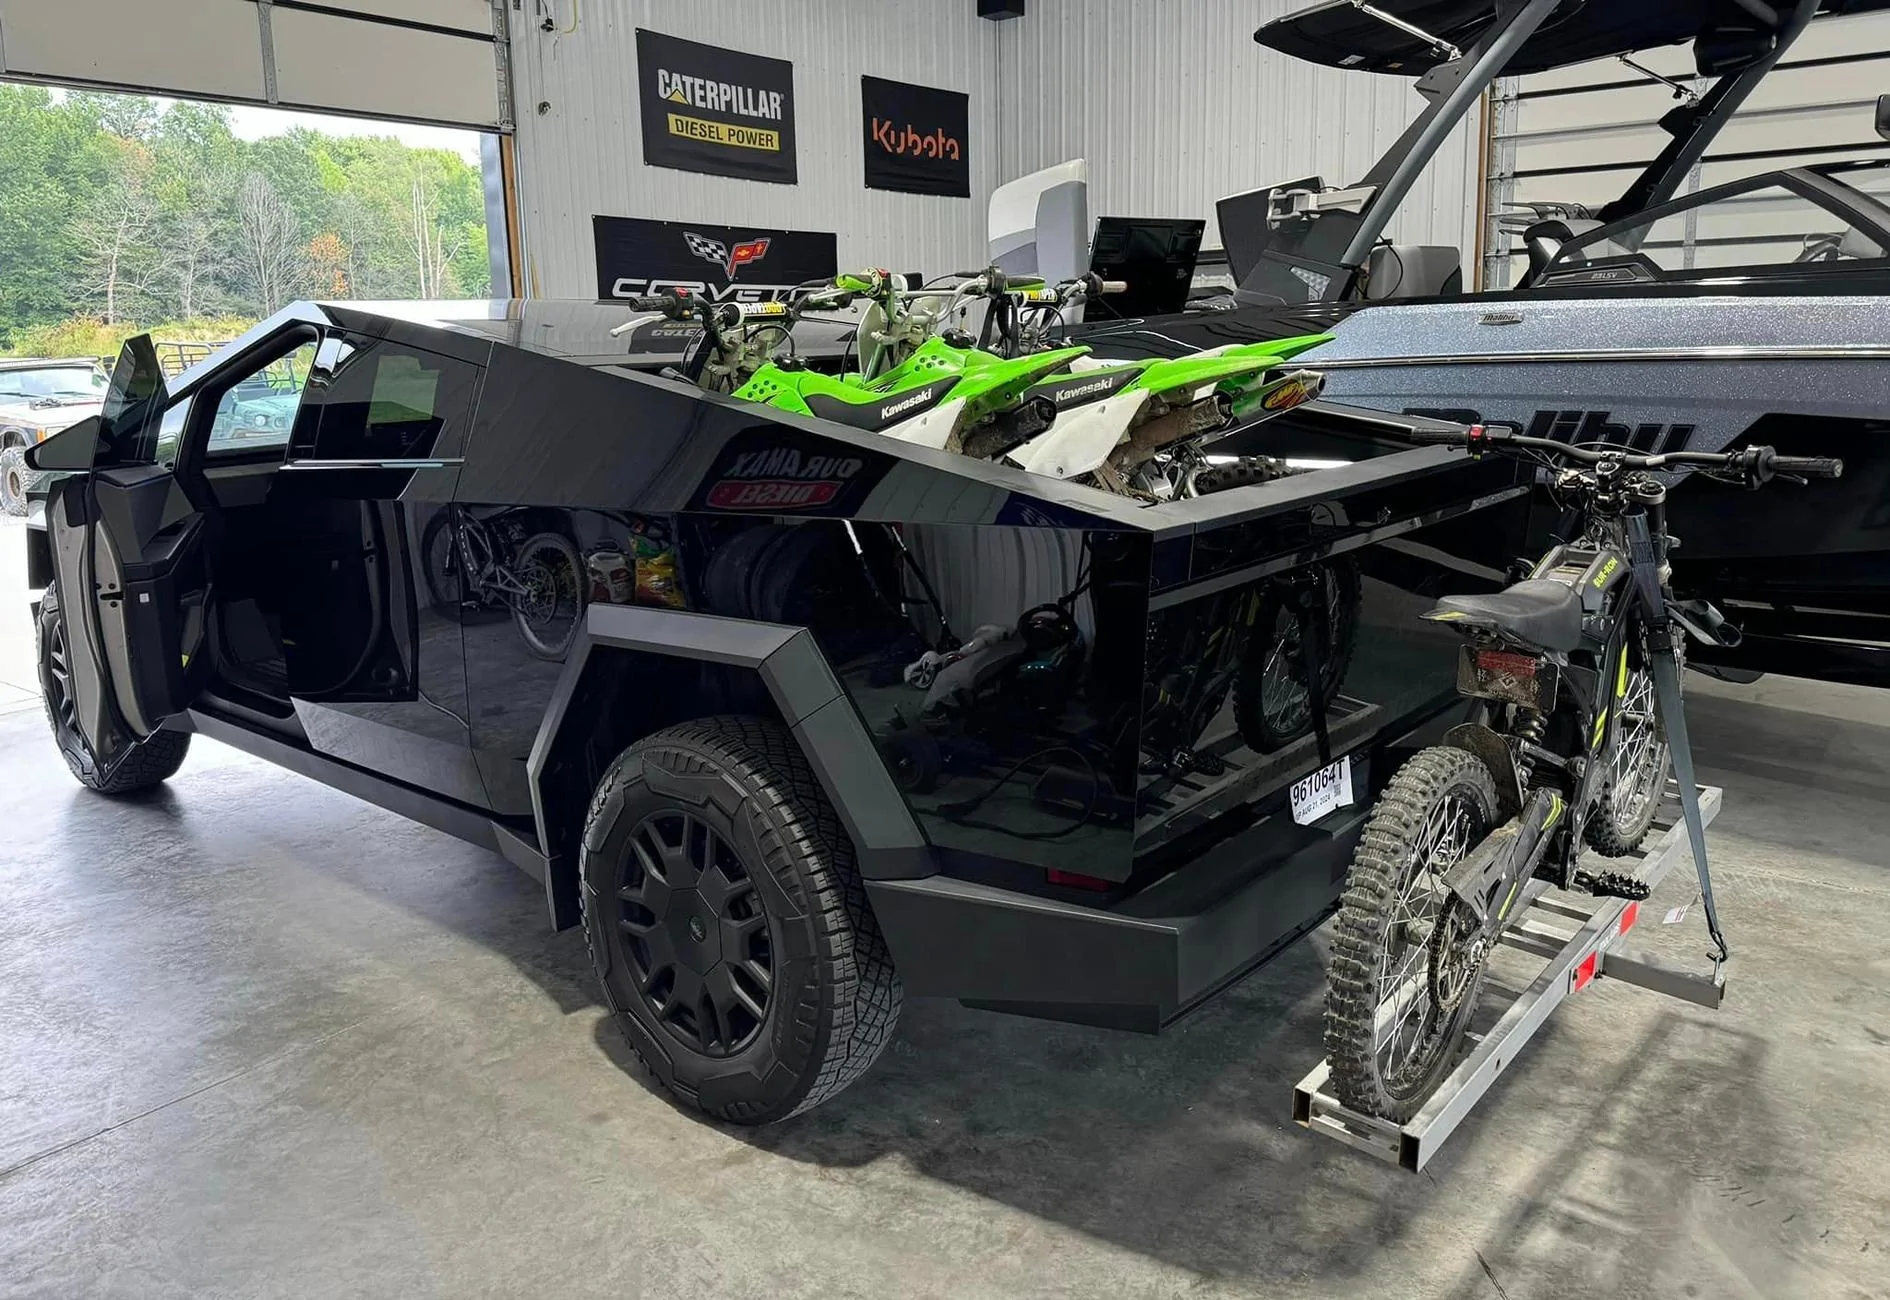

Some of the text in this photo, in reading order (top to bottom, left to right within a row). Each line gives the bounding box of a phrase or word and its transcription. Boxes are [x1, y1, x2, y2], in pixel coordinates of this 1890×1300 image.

[658, 68, 782, 120] CATERPILLAR
[675, 118, 774, 148] DIESEL POWER
[872, 117, 959, 160] Kubota
[881, 388, 932, 420] Kawasaki
[1055, 377, 1113, 402] Kawasaki
[1293, 758, 1345, 807] 961064T
